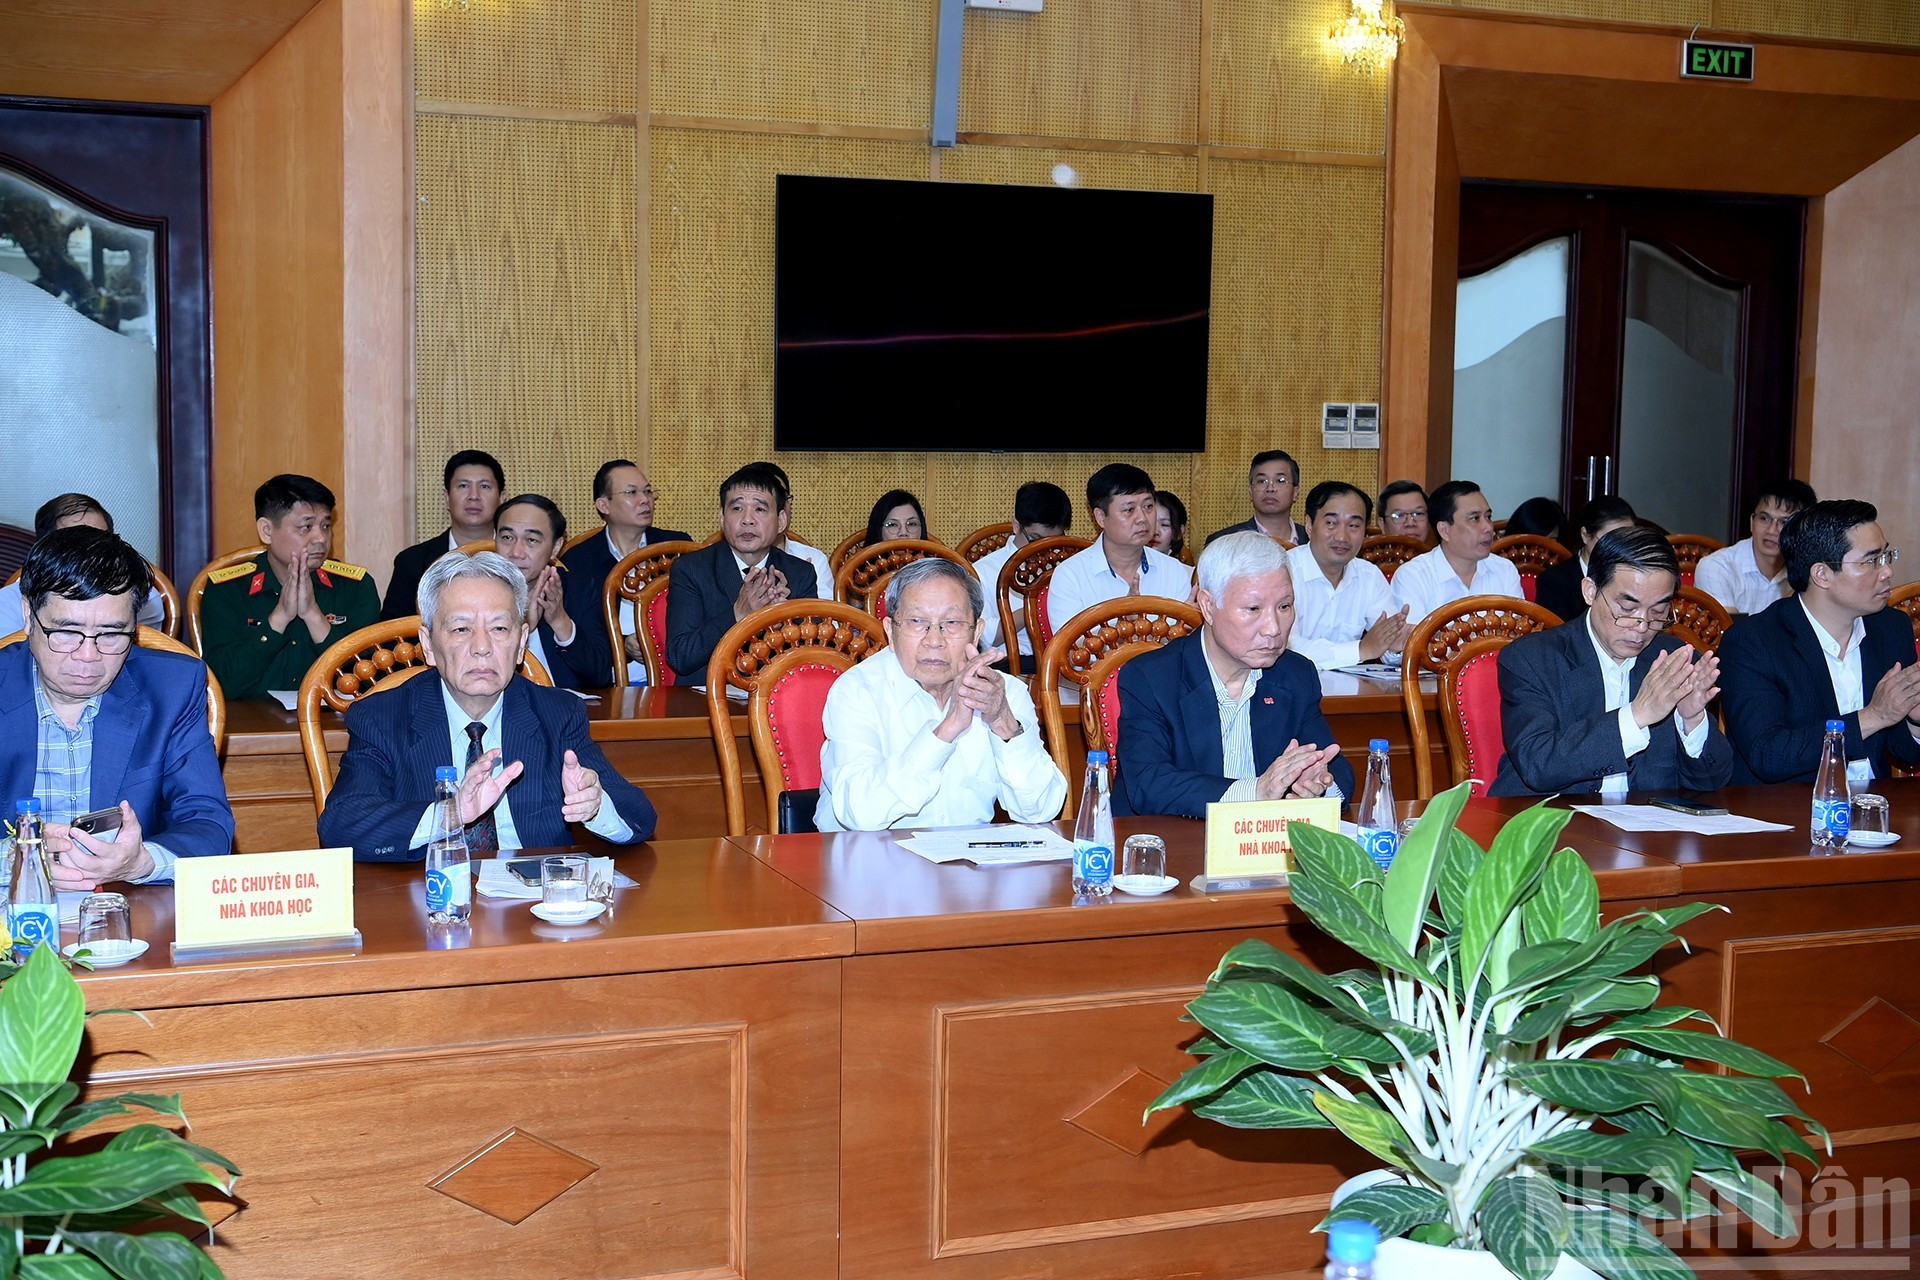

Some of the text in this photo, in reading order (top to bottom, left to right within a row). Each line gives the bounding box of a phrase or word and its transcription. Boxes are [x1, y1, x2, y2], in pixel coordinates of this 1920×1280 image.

[1693, 47, 1745, 75] EXIT
[1234, 818, 1253, 834] CÁC
[1239, 840, 1259, 856] NHÀ
[1261, 841, 1286, 855] KHOA
[1372, 838, 1396, 854] ICY
[1085, 853, 1111, 870] ICY
[212, 872, 319, 894] CÁC CHUYÊN GIA,
[427, 878, 448, 895] CY
[220, 898, 312, 919] NHÀ KHOA HỌC
[16, 918, 49, 939] ICY
